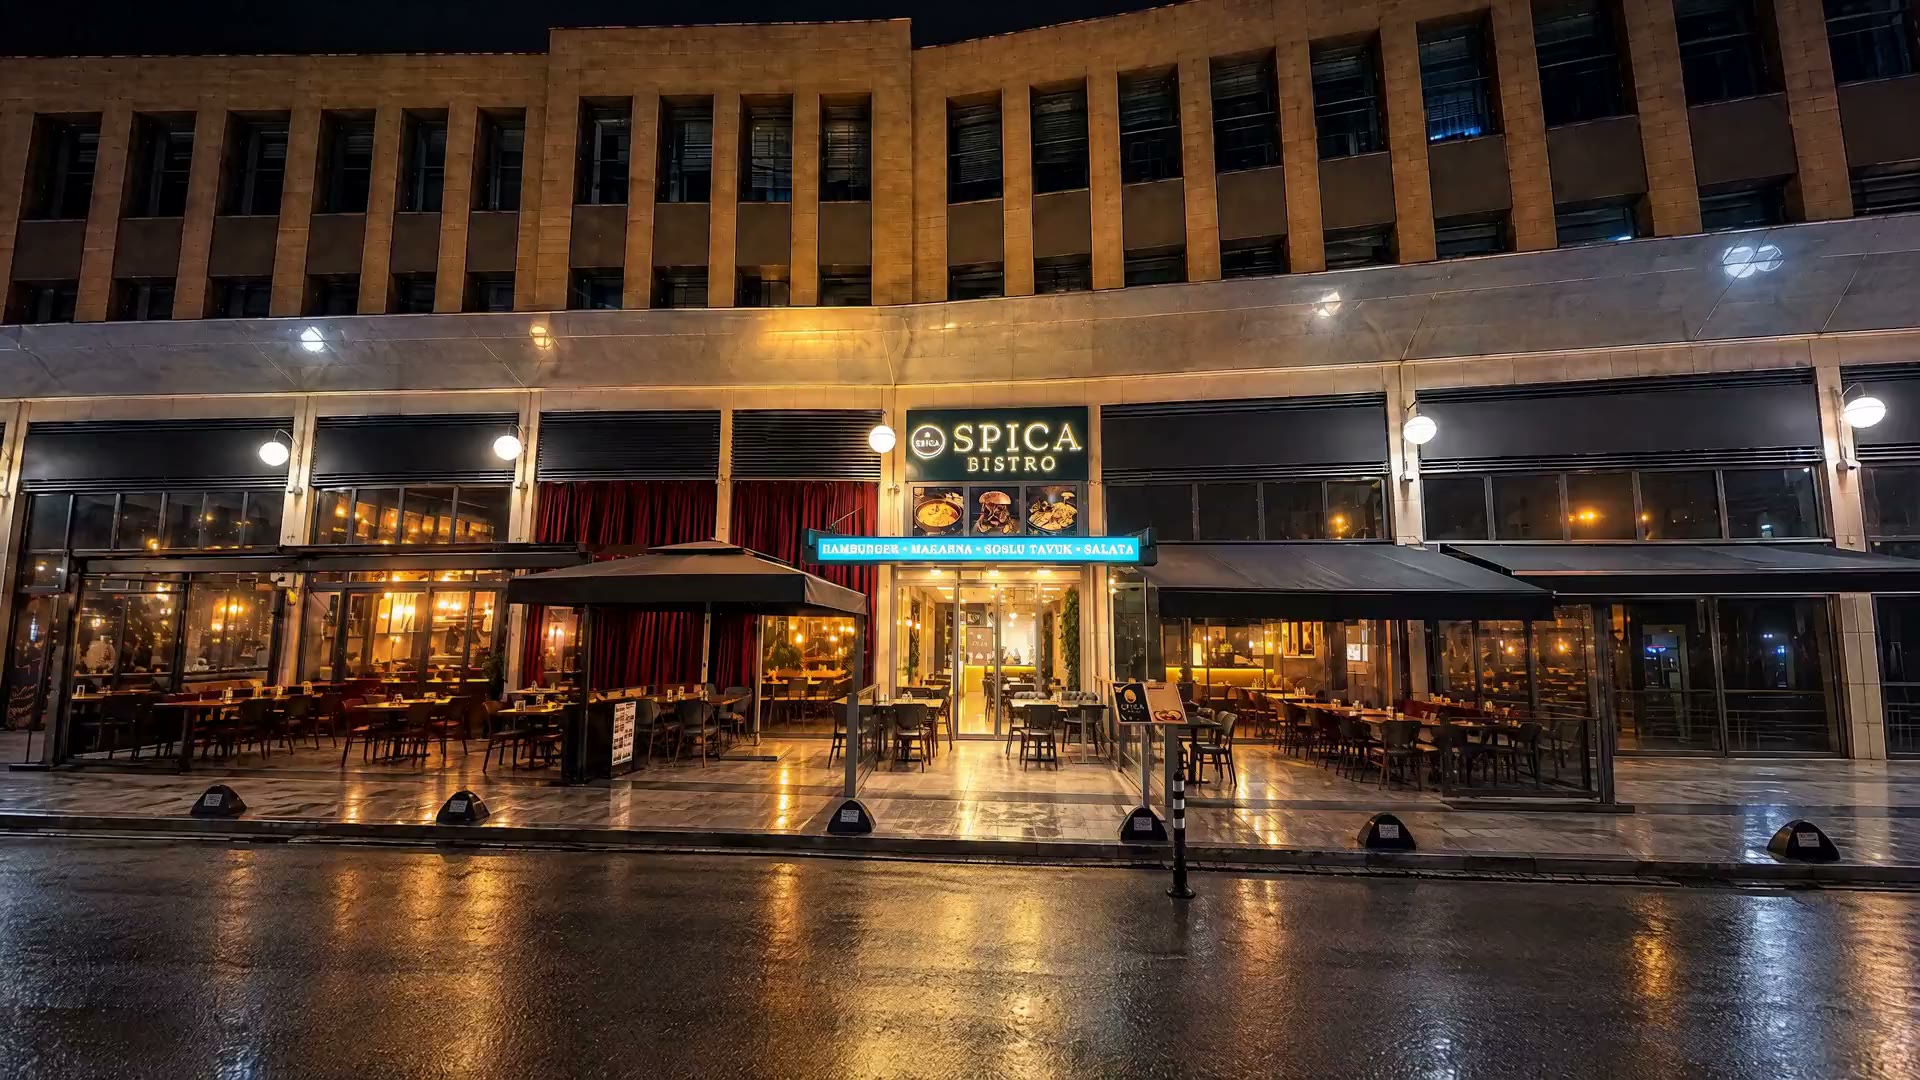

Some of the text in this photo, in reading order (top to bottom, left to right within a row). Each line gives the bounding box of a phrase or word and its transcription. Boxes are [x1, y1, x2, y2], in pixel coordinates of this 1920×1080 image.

[953, 423, 1082, 452] SPICA
[967, 456, 1056, 472] BISTRO
[911, 543, 972, 554] MAKARNA
[984, 543, 1025, 554] SOSLU
[1029, 543, 1072, 554] TAVUK
[1084, 543, 1134, 554] SALATA
